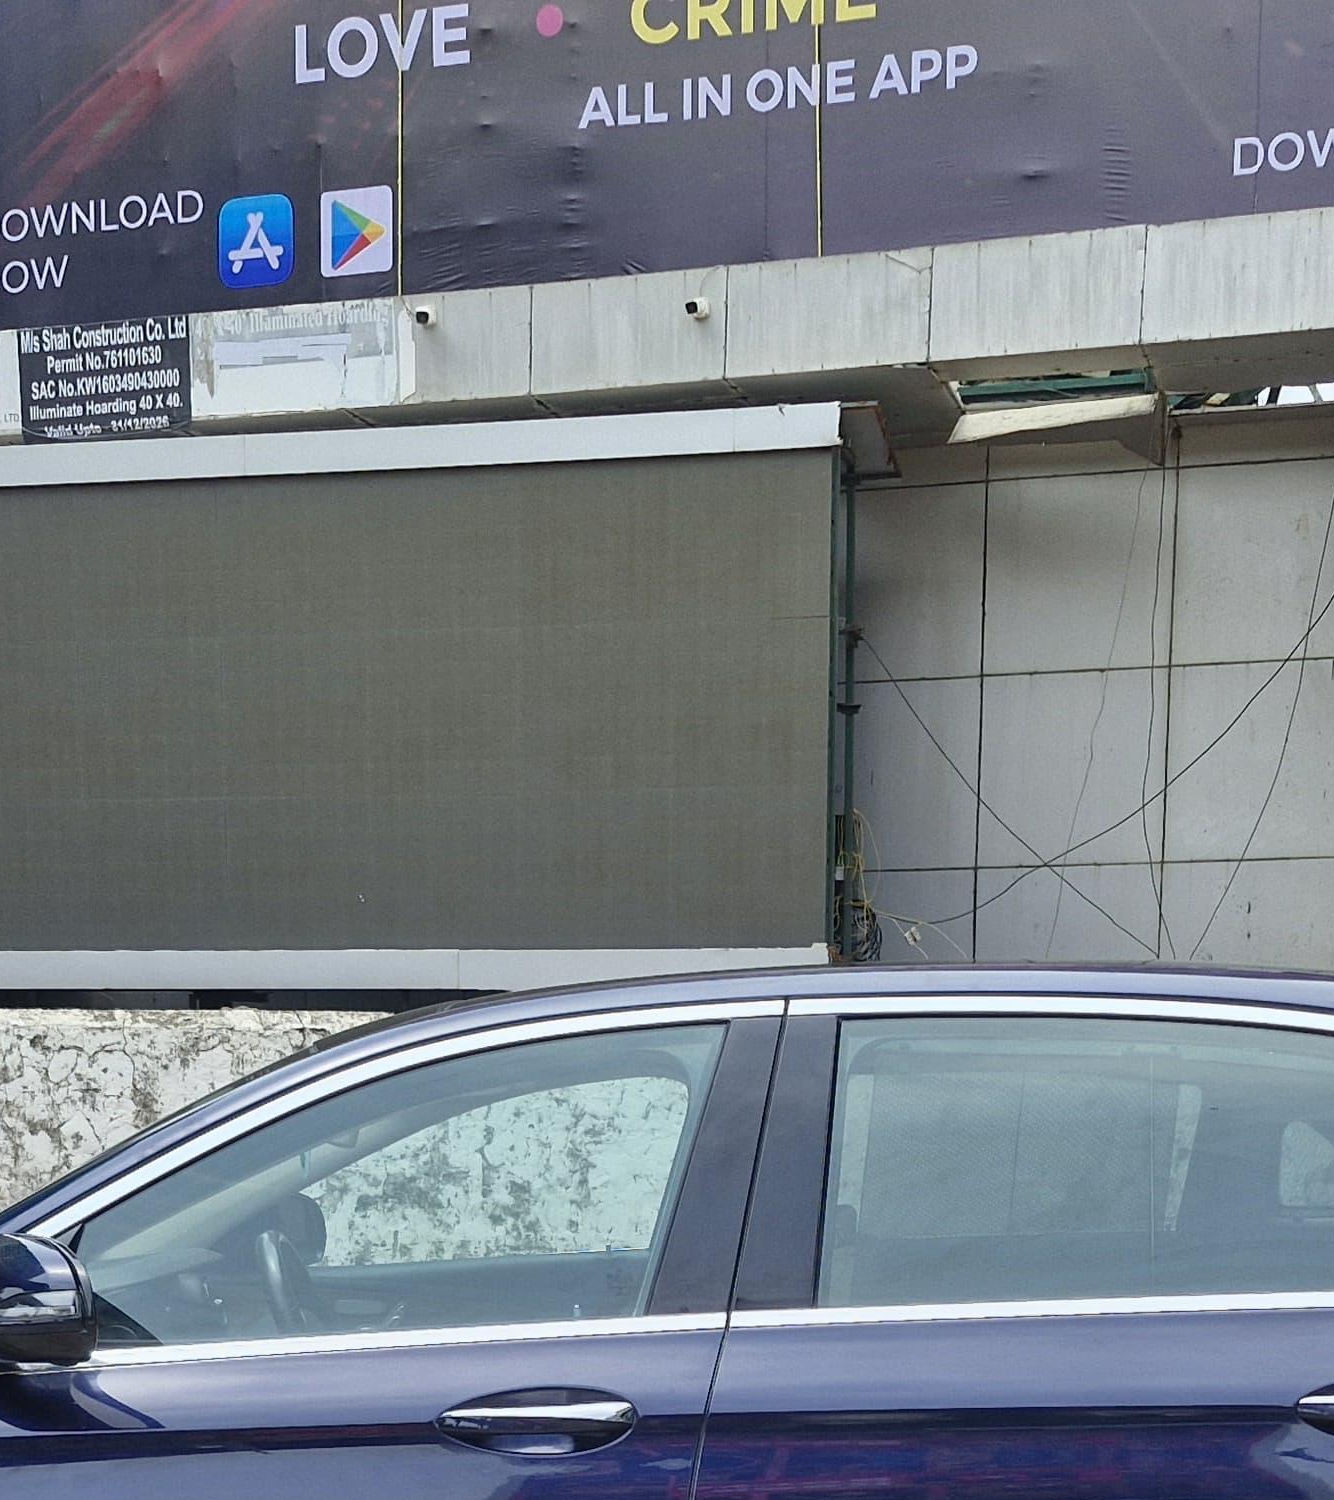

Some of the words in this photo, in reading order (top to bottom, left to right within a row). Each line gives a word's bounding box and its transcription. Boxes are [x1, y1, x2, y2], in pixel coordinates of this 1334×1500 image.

[294, 3, 470, 85] LOVE
[578, 81, 668, 130] ALL
[683, 73, 732, 121] IN
[746, 58, 856, 113] ONE
[869, 44, 979, 99] APP
[42, 327, 71, 351] Shah
[73, 321, 145, 349] Construction
[146, 318, 165, 341] Co.
[168, 316, 186, 340] Ltd
[47, 351, 83, 375] Permit
[31, 380, 56, 400] SAC
[29, 404, 83, 421] Illuminate
[86, 398, 137, 416] Hoarding
[139, 395, 153, 410] 40
